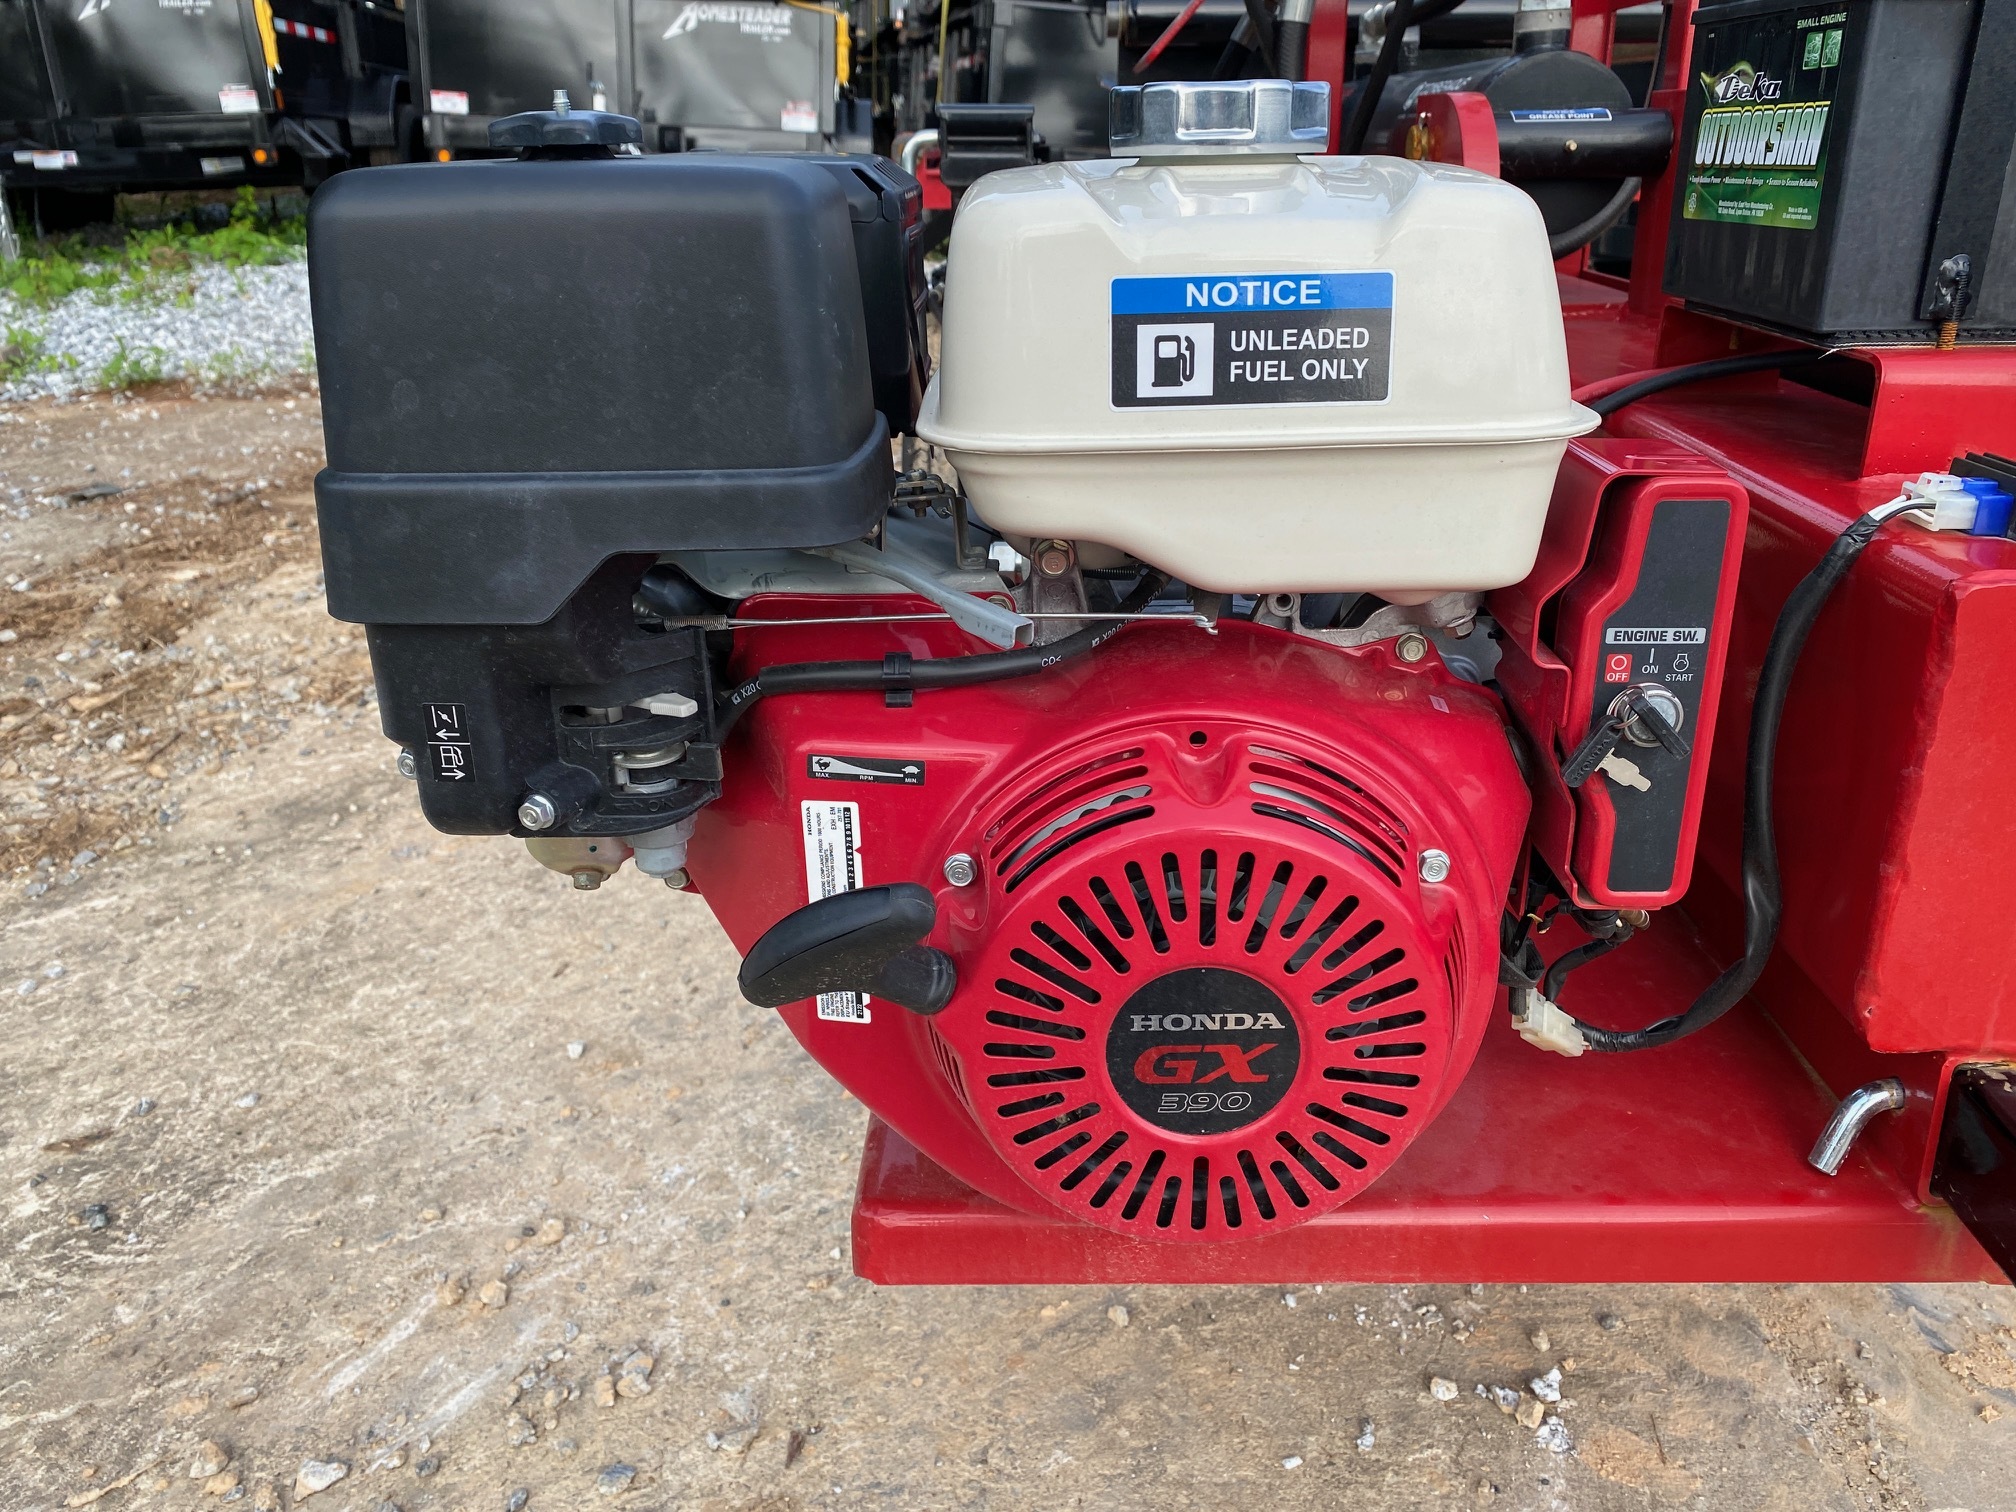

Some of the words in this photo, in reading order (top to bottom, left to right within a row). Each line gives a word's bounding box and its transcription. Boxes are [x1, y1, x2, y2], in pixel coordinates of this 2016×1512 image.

[1797, 17, 1820, 29] SMALL
[1820, 12, 1848, 26] ENGINE
[1718, 72, 1782, 103] Deka
[1695, 102, 1831, 168] OUTDOORSMAN
[1186, 280, 1321, 307] NOTICE
[1230, 328, 1369, 351] UNLEADED
[1230, 361, 1294, 382] FUEL
[1301, 358, 1369, 380] ONLY
[1613, 630, 1668, 642] ENGINE
[1673, 630, 1699, 642] SW.
[1606, 672, 1629, 682] OFF
[1641, 665, 1659, 674] ON
[1665, 673, 1693, 682] START
[740, 683, 756, 698] X20
[830, 807, 836, 815] EM
[1130, 1012, 1285, 1031] HONDA
[1133, 1043, 1279, 1084] GX
[1157, 1091, 1252, 1113] 390
